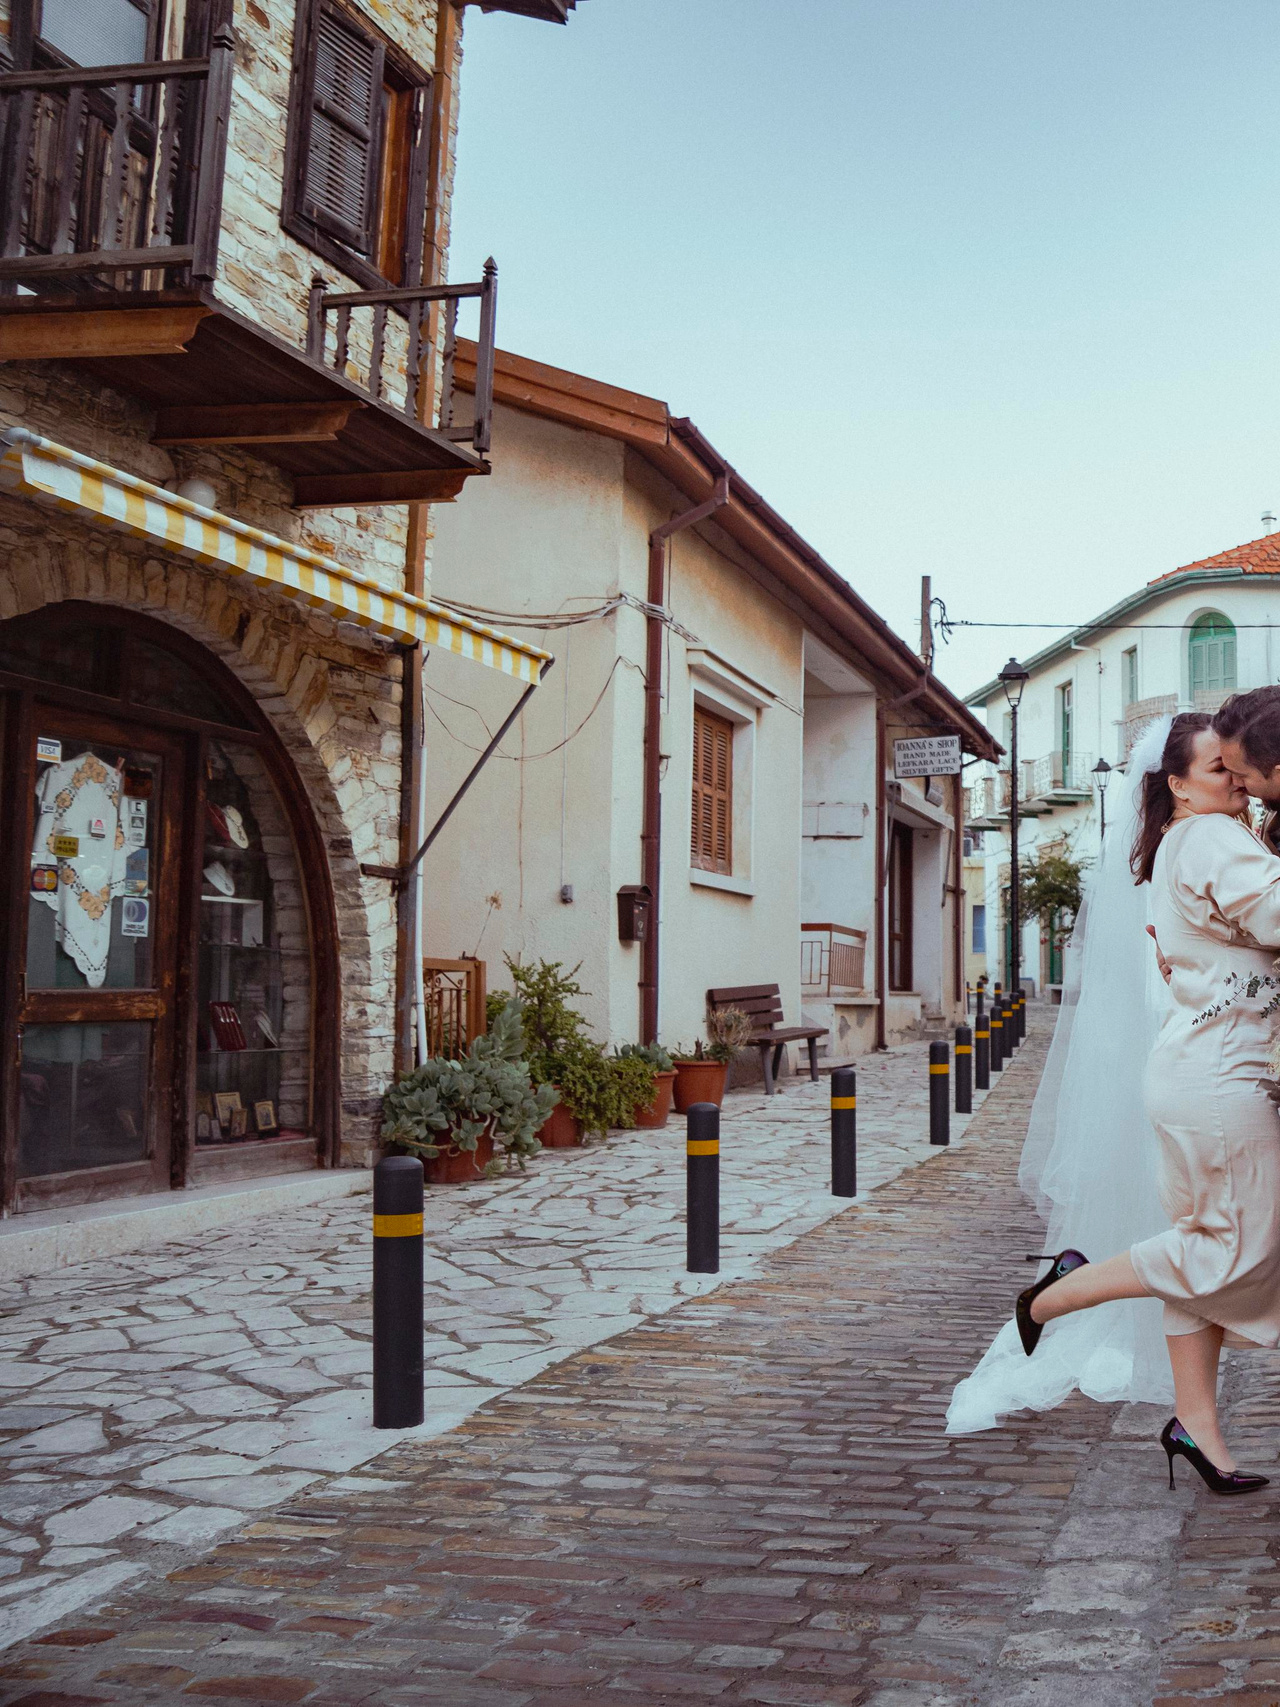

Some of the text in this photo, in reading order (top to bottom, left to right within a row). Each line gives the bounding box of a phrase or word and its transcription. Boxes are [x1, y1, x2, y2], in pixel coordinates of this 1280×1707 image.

[937, 738, 957, 749] SHOP
[40, 745, 56, 755] VISA
[903, 750, 951, 759] HAND MADE
[898, 757, 958, 768] LEFKARA LACE
[901, 767, 928, 775] SILVER
